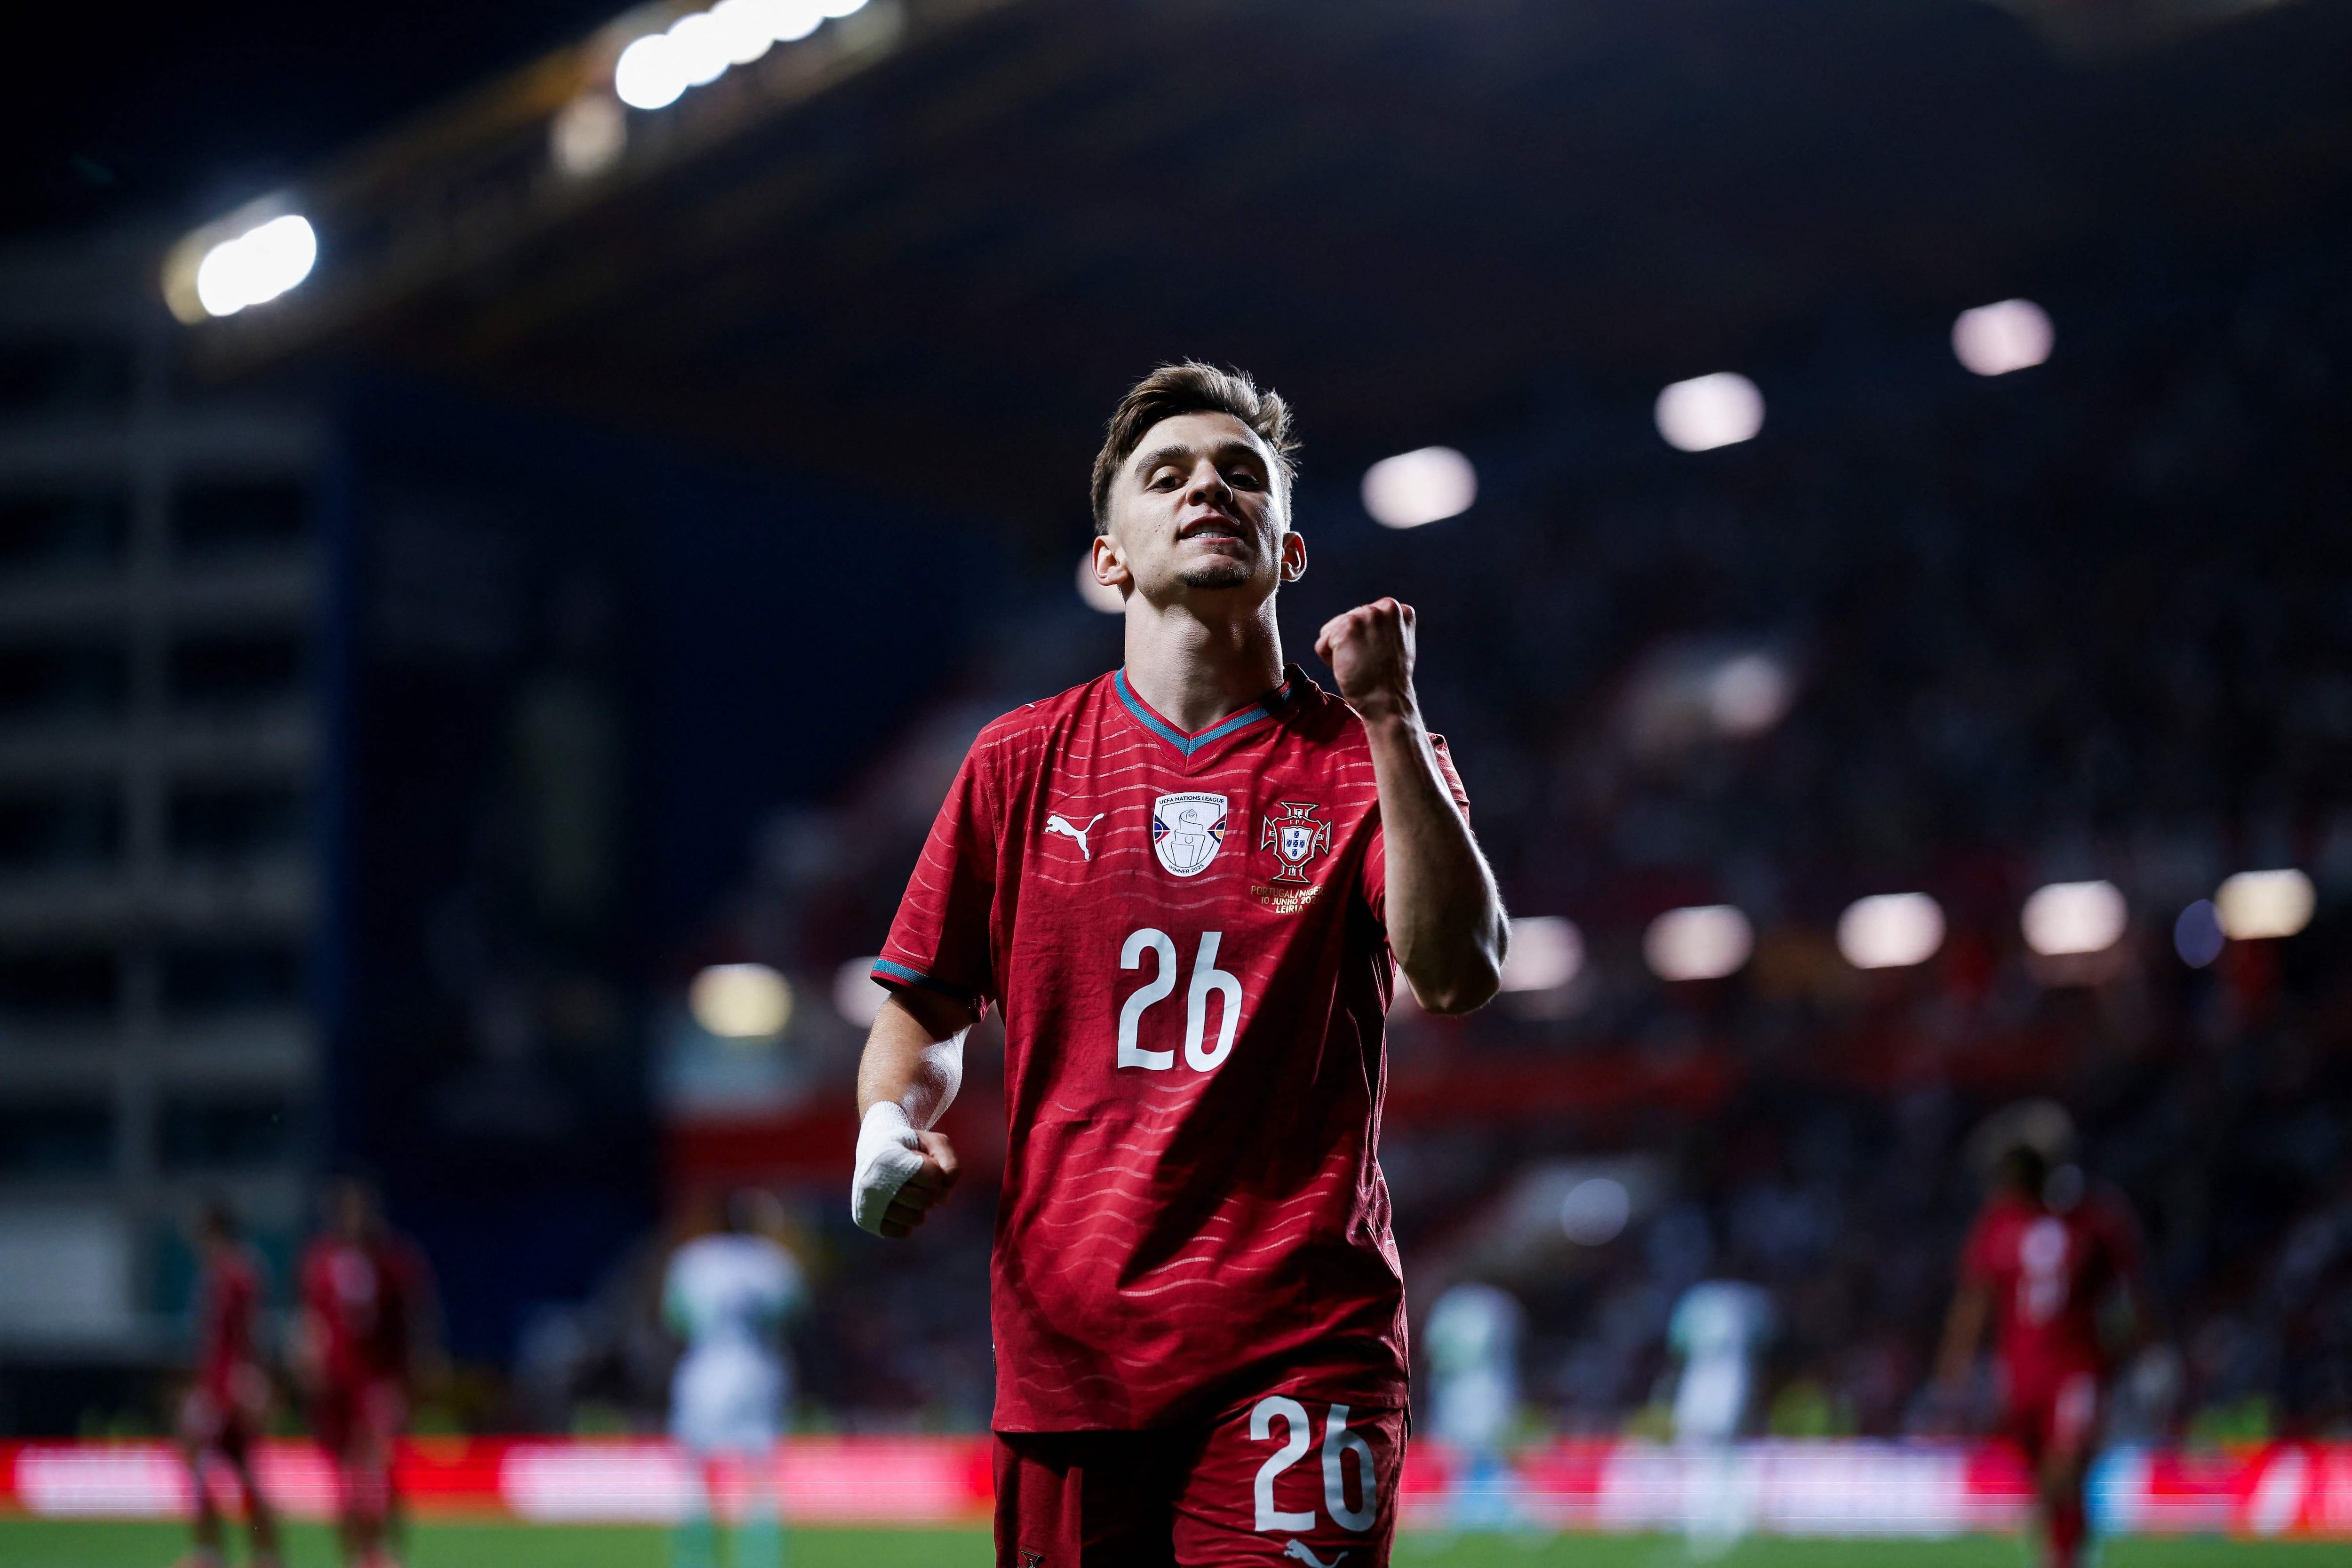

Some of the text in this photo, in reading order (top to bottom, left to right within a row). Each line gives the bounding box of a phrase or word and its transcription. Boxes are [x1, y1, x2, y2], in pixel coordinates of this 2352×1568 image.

[1168, 864, 1190, 874] WINNER
[1261, 896, 1270, 905] 10
[1271, 897, 1298, 905] JUNHO
[1276, 904, 1304, 914] LEIRIA
[1118, 928, 1242, 1073] 26
[1249, 1395, 1377, 1532] 26
